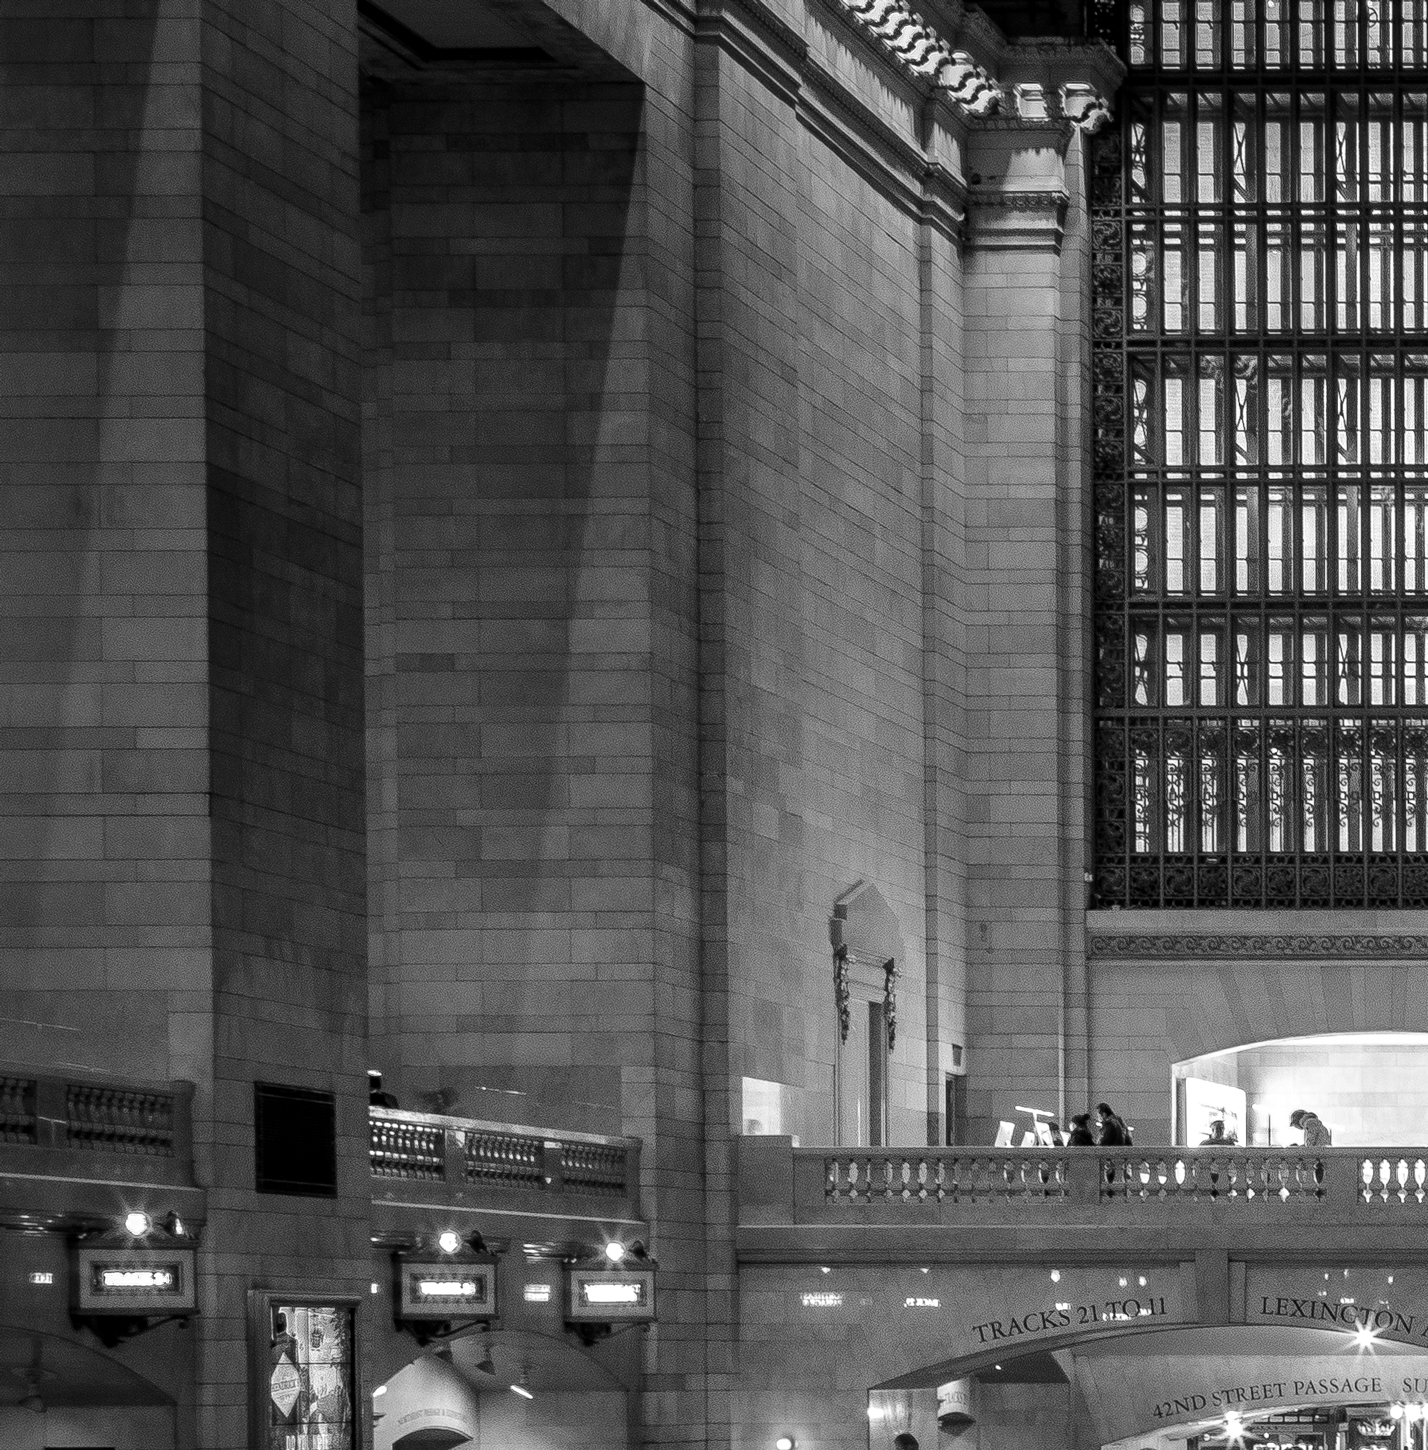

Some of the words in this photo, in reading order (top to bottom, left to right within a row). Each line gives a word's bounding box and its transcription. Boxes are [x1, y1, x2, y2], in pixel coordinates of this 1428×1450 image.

[972, 1308, 1071, 1344] TRACKS
[1076, 1304, 1099, 1325] 21
[1106, 1298, 1140, 1320] TO
[1149, 1296, 1169, 1316] 11
[1260, 1295, 1413, 1336] LEXINGTON
[1152, 1393, 1207, 1420] 42ND
[1211, 1382, 1287, 1407] STREET
[1293, 1377, 1383, 1396] PASSAGE
